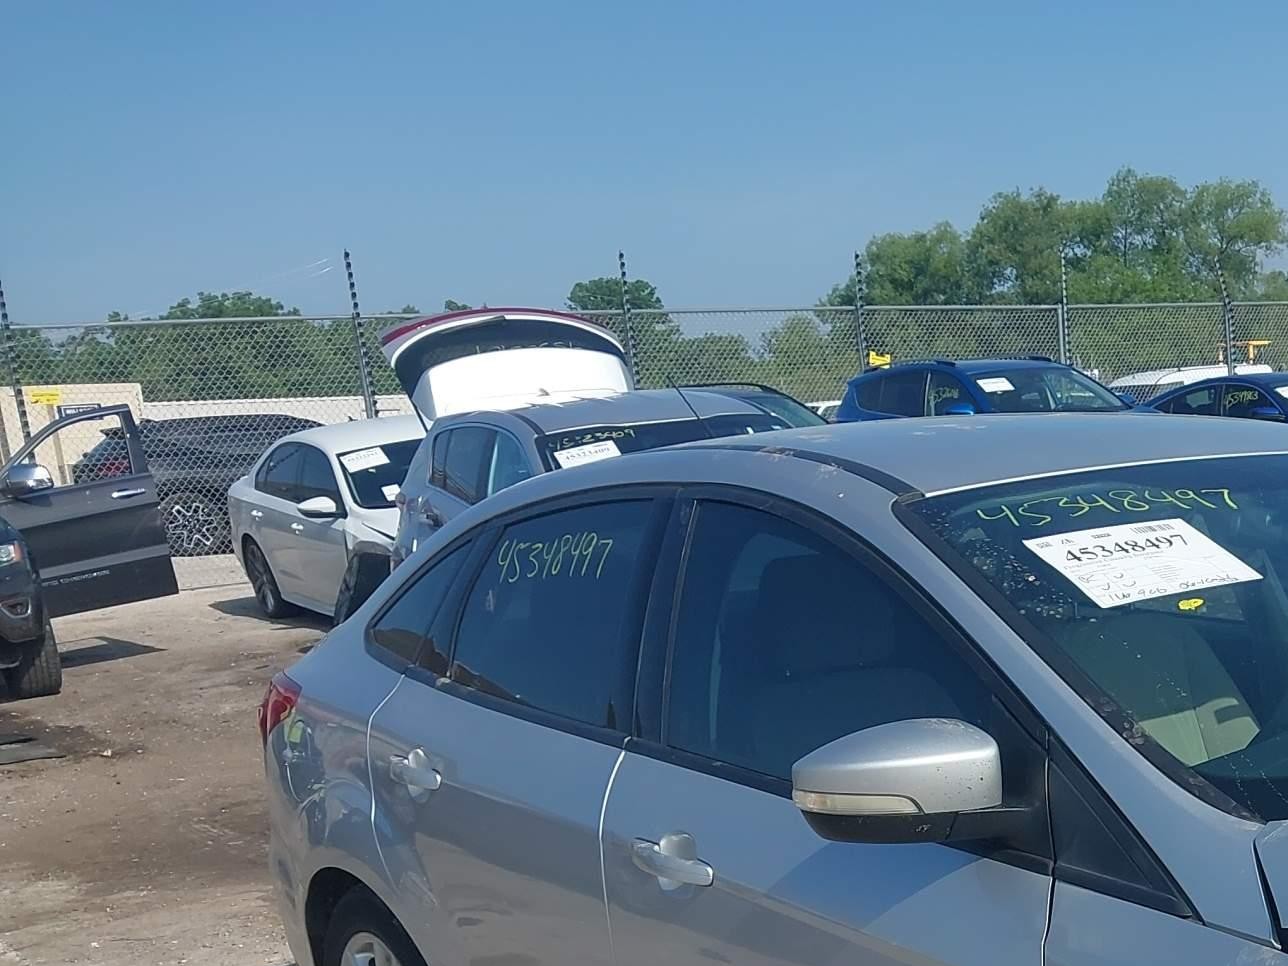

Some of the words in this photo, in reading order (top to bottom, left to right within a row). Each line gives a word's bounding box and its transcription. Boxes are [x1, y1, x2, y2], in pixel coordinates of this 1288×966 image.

[977, 488, 1239, 527] 45348497
[498, 532, 613, 583] 45348497
[1066, 534, 1188, 562] 45348497
